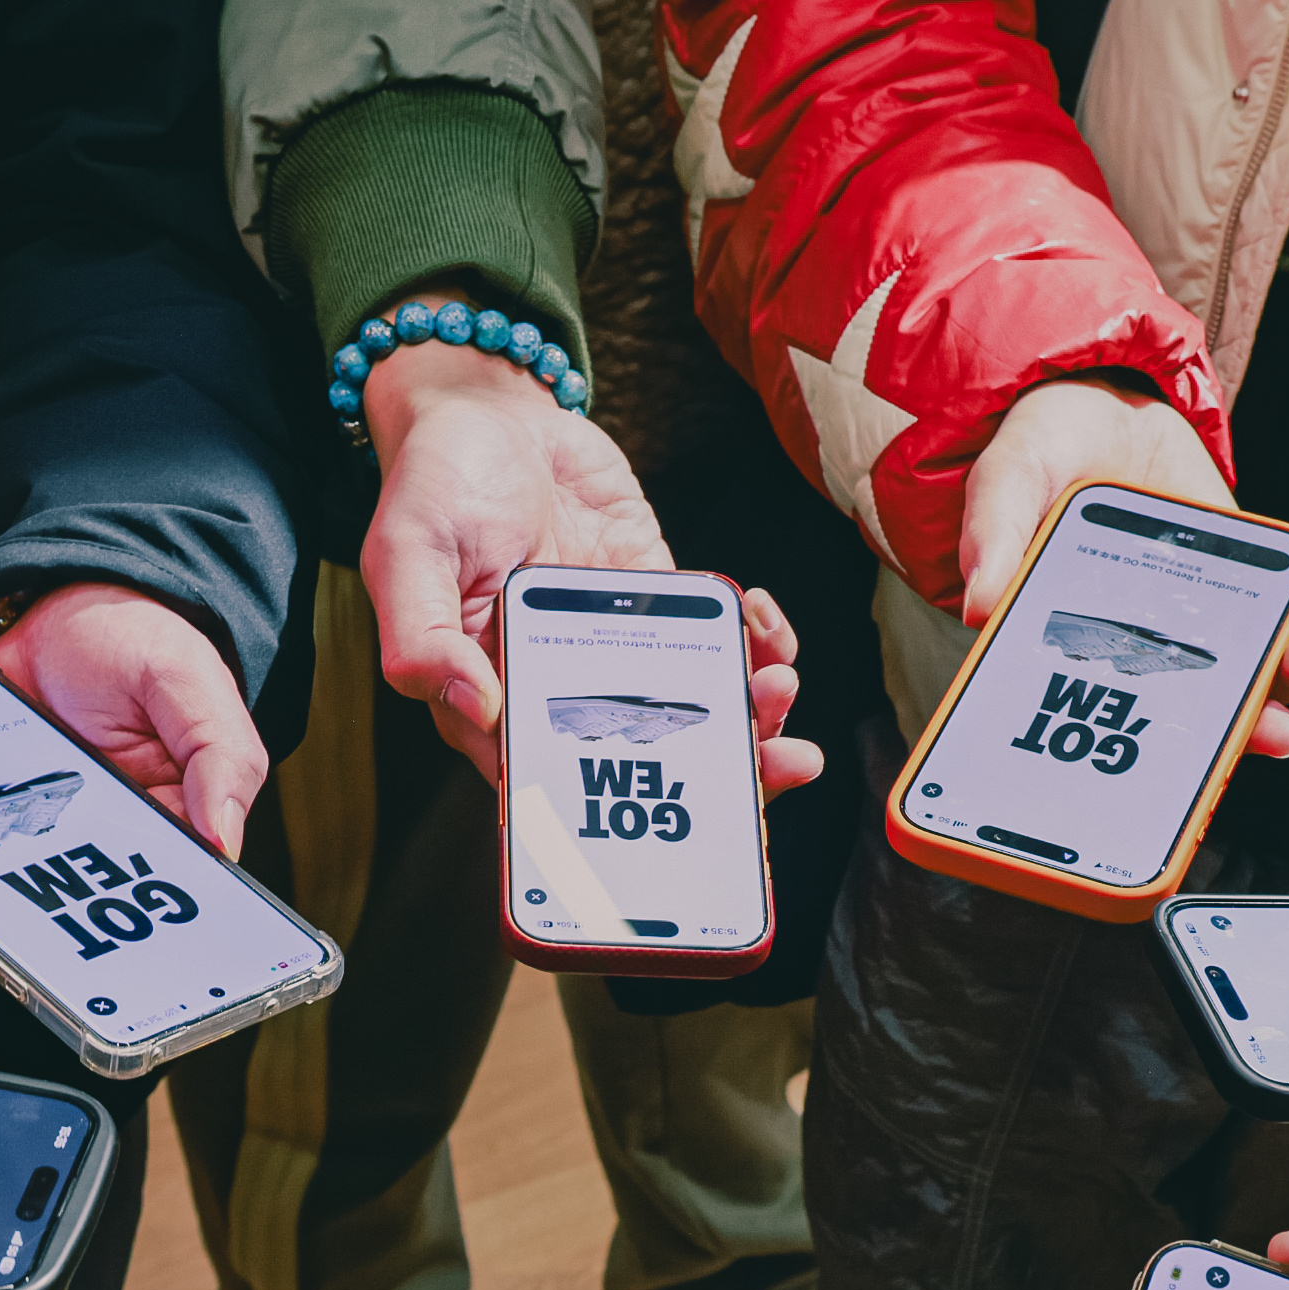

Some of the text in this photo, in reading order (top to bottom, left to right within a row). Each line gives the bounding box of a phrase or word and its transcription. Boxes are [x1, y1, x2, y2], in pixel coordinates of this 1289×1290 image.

[1121, 556, 1139, 567] OG
[1139, 561, 1163, 573] Low
[1163, 567, 1194, 581] Retro
[1195, 575, 1202, 583] 1
[1203, 578, 1242, 594] Jordan
[1243, 588, 1260, 599] Air
[613, 598, 632, 606] 分享
[527, 634, 721, 652] Air Jordan 1 Retro Low OG 新年系列
[1040, 672, 1150, 735] 'EM
[10, 717, 30, 727] Air
[1010, 712, 1138, 774] GOT
[579, 758, 683, 799] 'EM
[578, 799, 690, 841] GOT
[1104, 864, 1133, 878] 15:35
[51, 880, 198, 960] GOT
[710, 927, 737, 935] 15:35
[1249, 1042, 1268, 1063] 15:35
